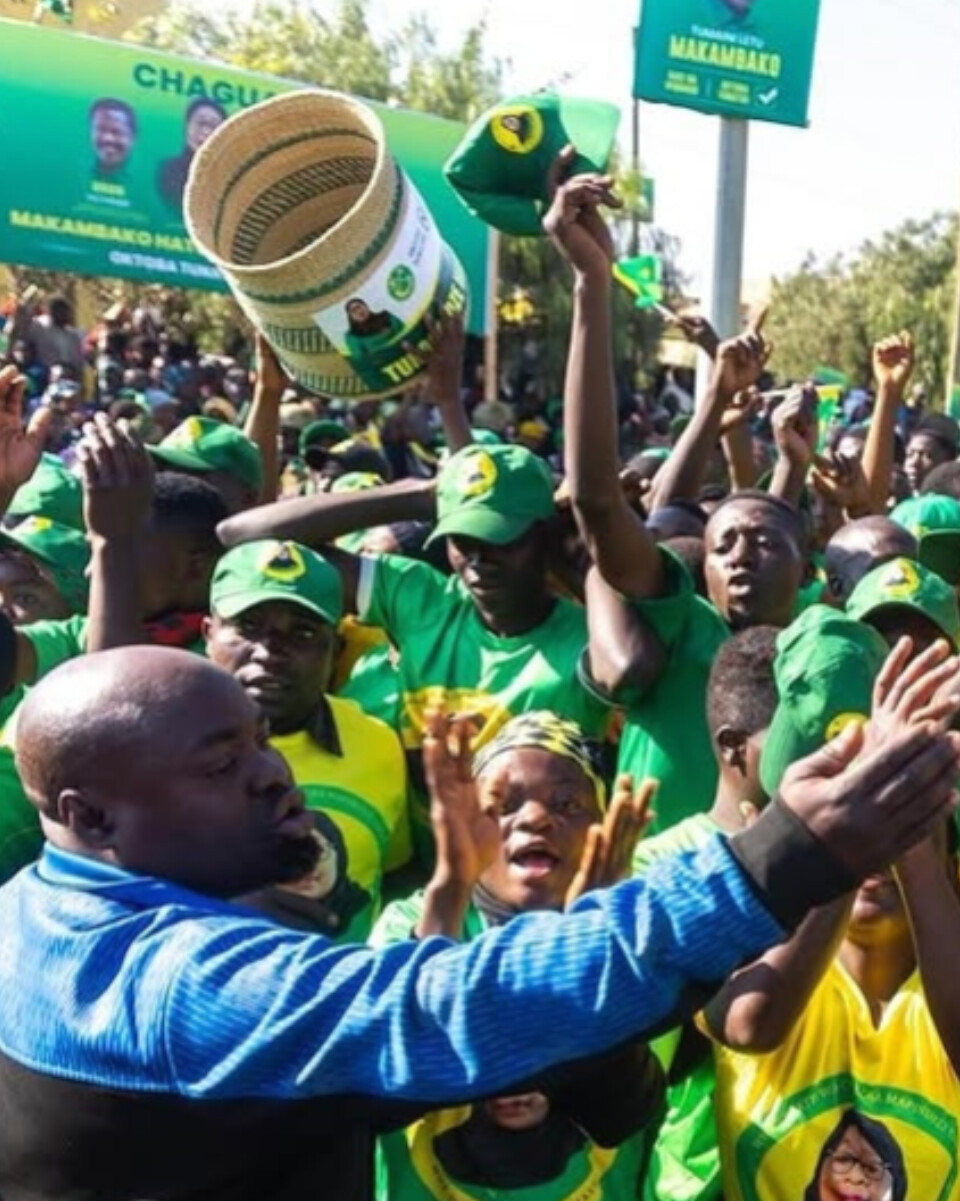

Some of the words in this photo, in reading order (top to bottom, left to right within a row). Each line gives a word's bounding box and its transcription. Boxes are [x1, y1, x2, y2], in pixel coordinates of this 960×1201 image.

[668, 34, 781, 78] MAKAMBAKO
[133, 62, 275, 107] CHAGU
[10, 210, 152, 246] MAKAMBAKO
